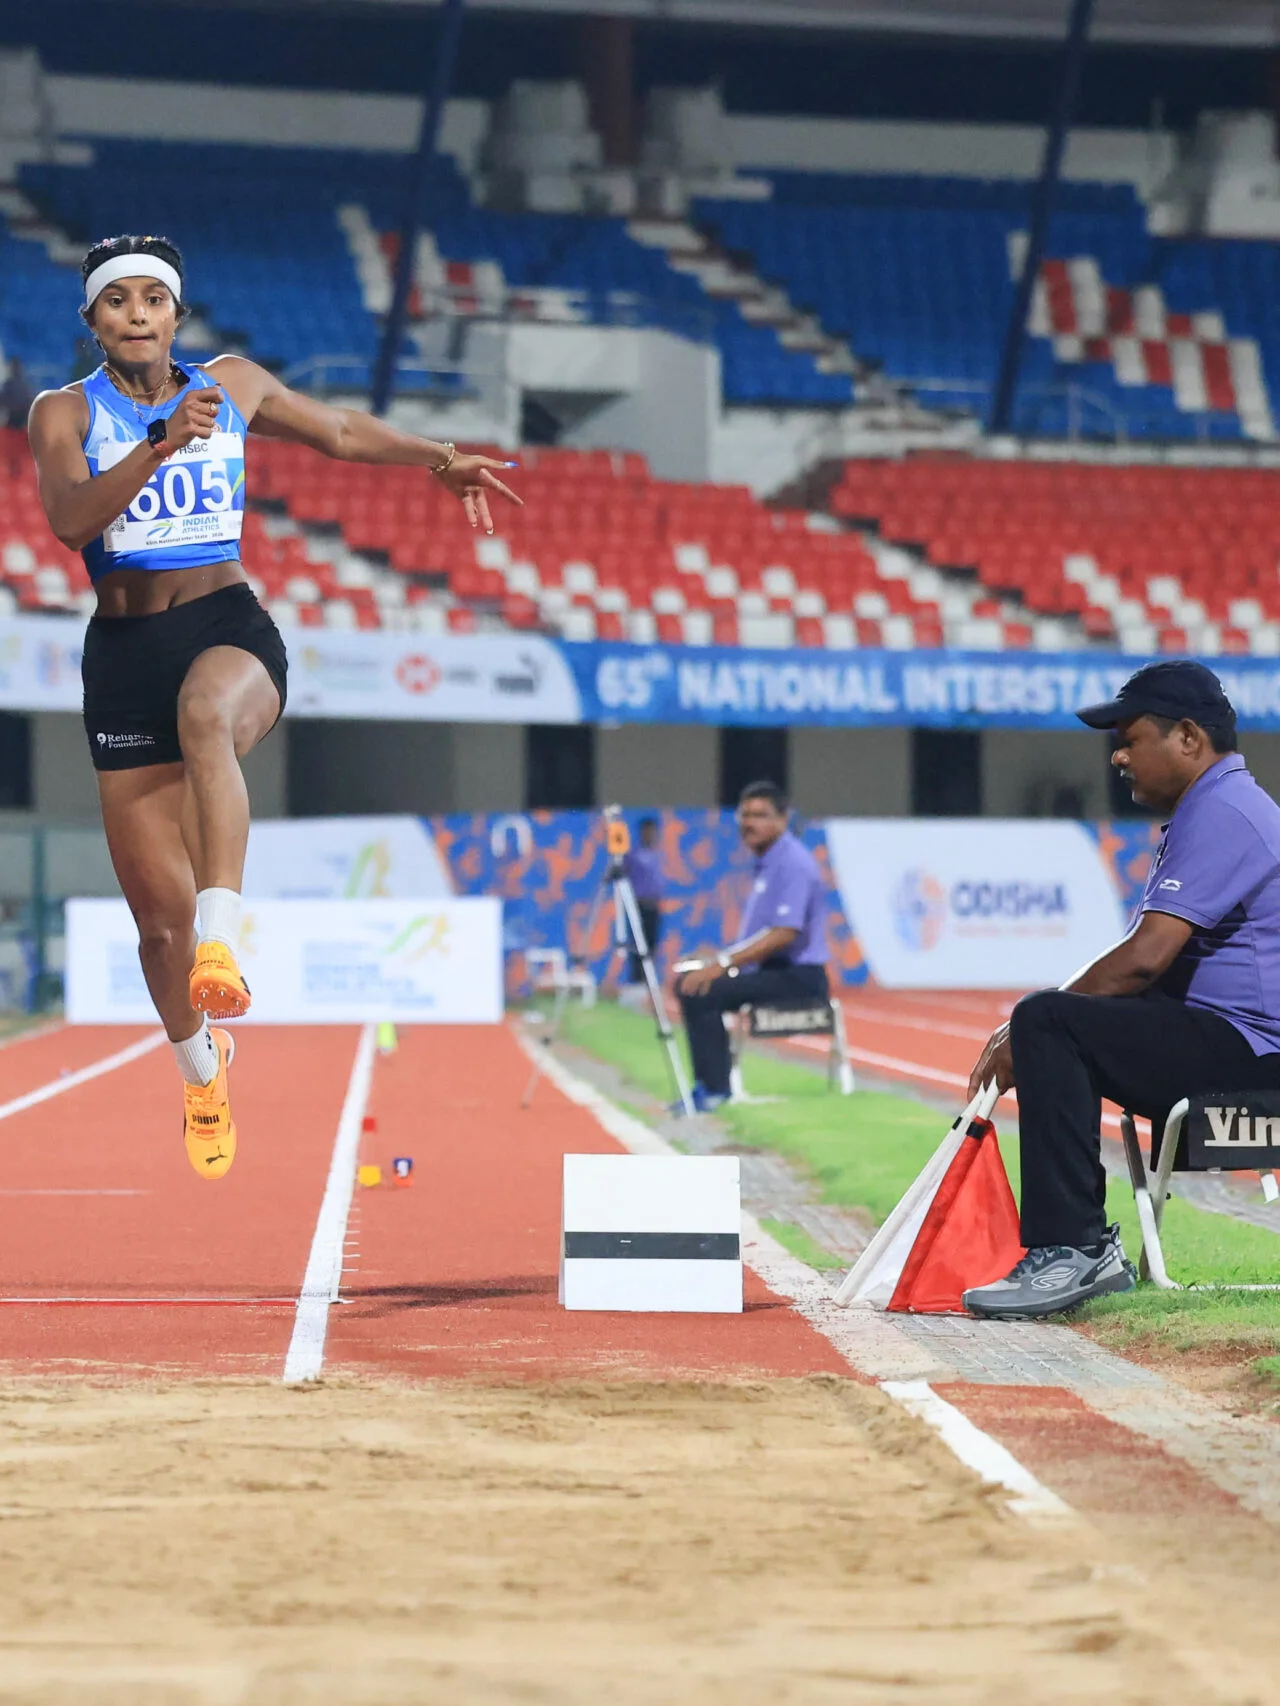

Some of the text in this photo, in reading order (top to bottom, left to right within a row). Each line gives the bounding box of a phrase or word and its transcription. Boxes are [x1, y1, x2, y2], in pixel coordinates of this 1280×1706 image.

[180, 442, 209, 455] HSBC
[129, 460, 233, 521] 605
[183, 515, 219, 527] INDIAN
[183, 524, 220, 534] ATHLETICS
[678, 659, 898, 713] NATIONAL
[904, 663, 1136, 715] INTERSTAT
[1204, 1107, 1280, 1147] Vin
